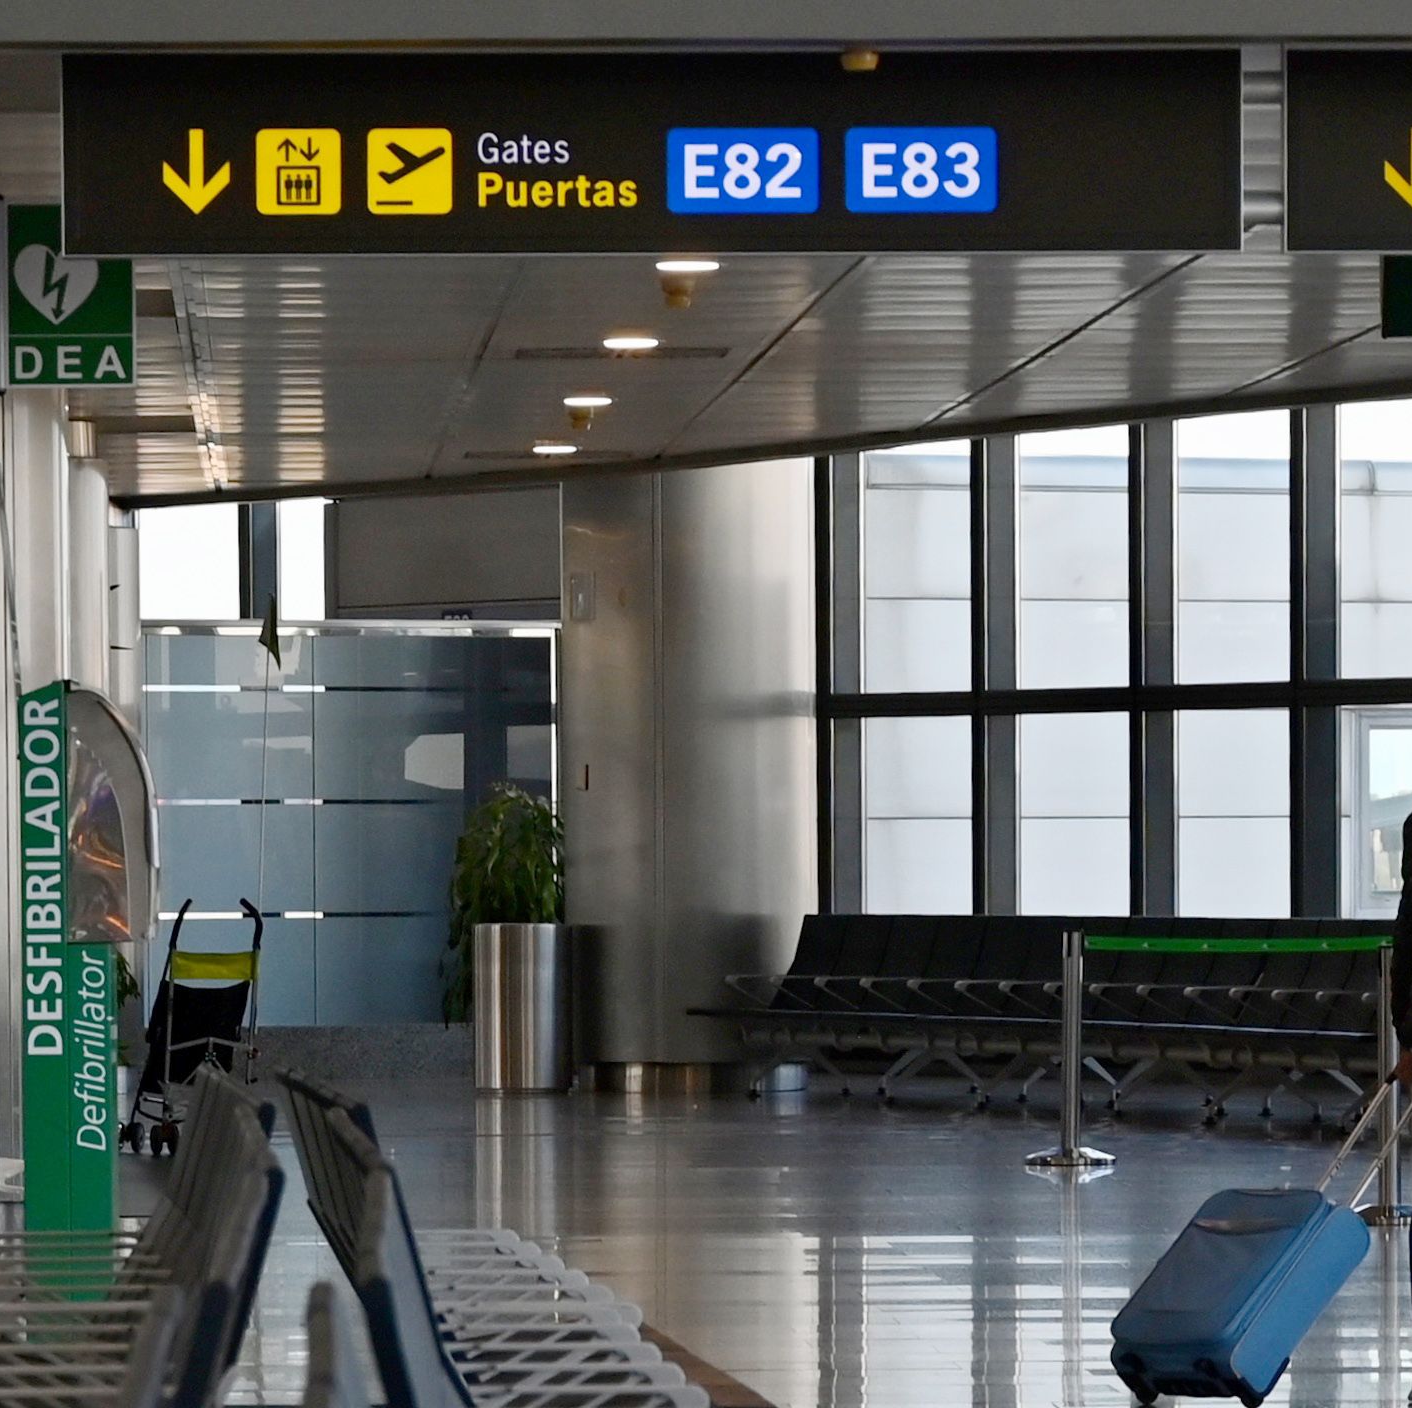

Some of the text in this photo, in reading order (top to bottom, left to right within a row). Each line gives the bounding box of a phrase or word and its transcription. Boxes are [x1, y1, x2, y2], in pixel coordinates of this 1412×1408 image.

[477, 132, 570, 164] Gates
[684, 141, 981, 199] E82 E83
[477, 171, 638, 208] Puertas
[14, 345, 127, 380] DEA
[23, 698, 64, 1057] DESFIBRILADOR
[74, 950, 107, 1151] Defibrillator
